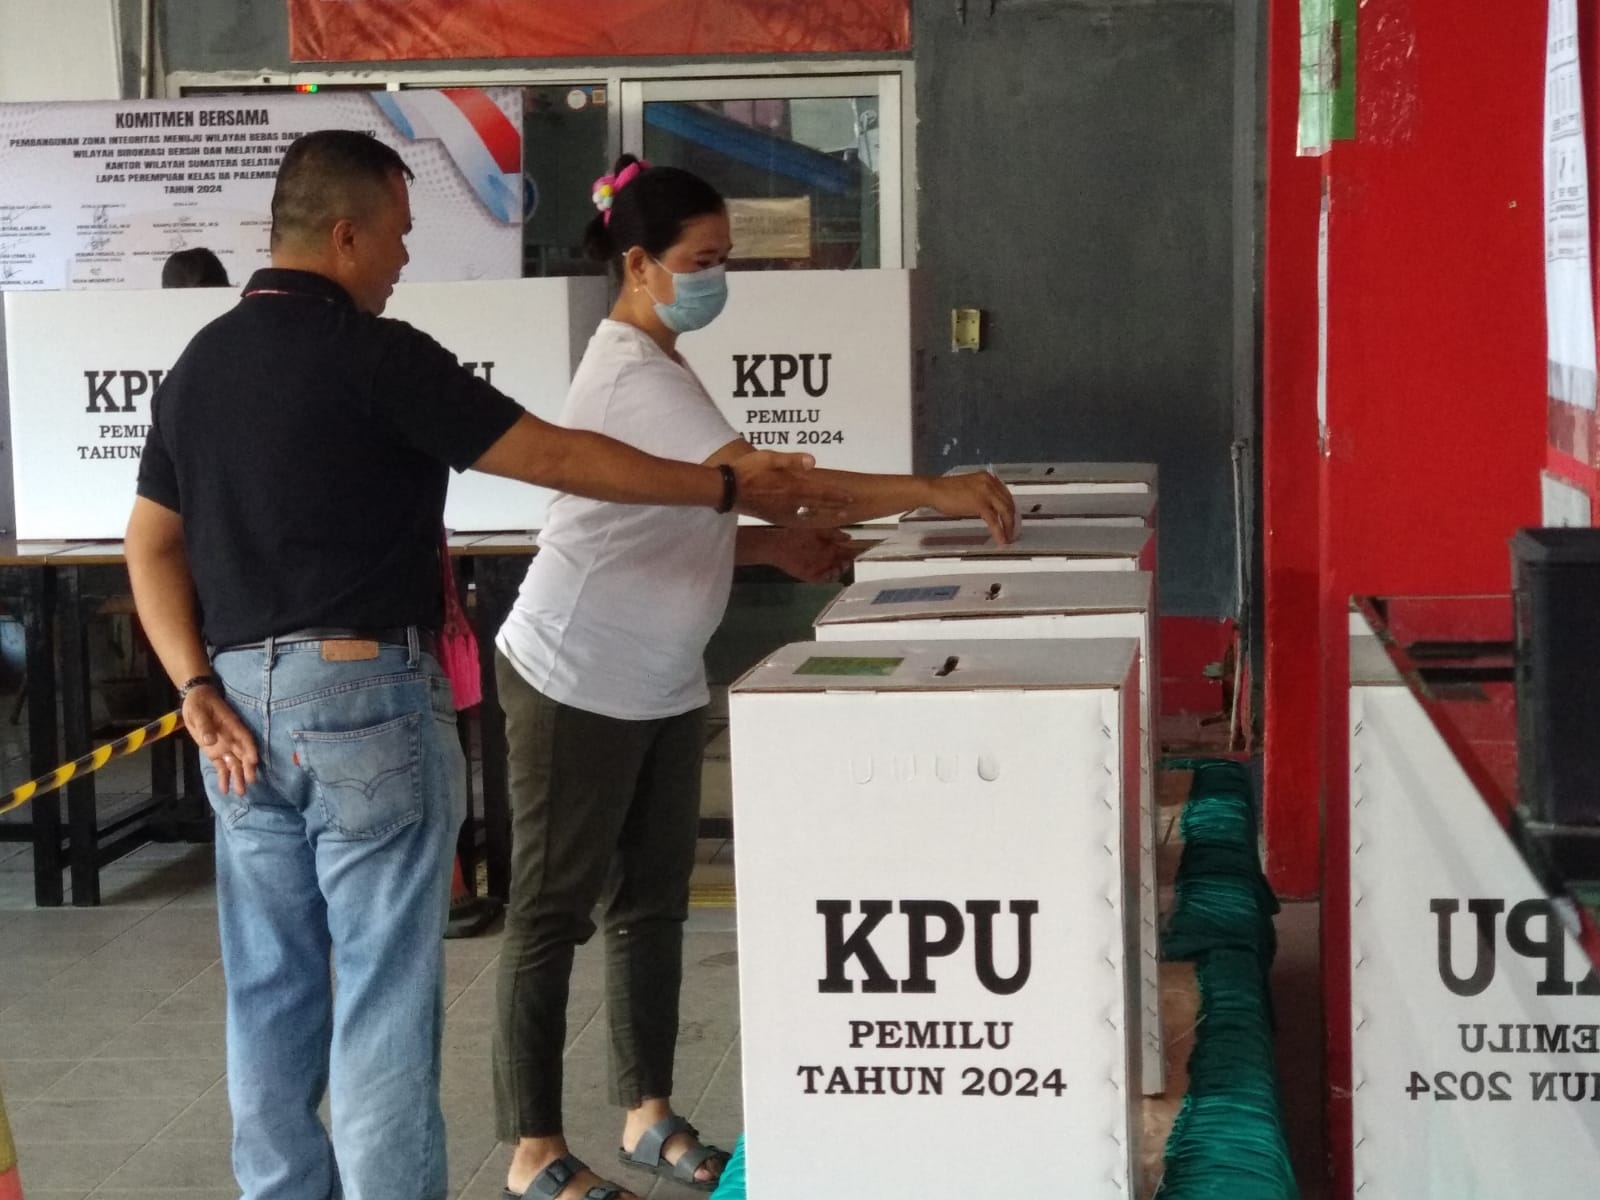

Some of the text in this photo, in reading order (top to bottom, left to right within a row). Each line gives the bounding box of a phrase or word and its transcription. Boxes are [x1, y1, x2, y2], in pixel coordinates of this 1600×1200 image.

[115, 109, 269, 128] KOMITMEN BERSAMA
[9, 137, 80, 147] PEMBANGUNAN
[82, 136, 106, 145] ZONA
[108, 135, 161, 145] INTEGRITAS
[163, 134, 202, 143] MENUJU
[205, 133, 247, 142] WILAYAH
[249, 132, 279, 141] BEBAS
[73, 149, 114, 158] WILAYAH
[117, 148, 165, 157] BIROKRASI
[168, 147, 200, 156] BERSIH
[203, 146, 222, 155] DAN
[225, 145, 272, 155] MELAYANI
[105, 158, 280, 170] KANTOR WILAYAH SUMATERA SELATAN
[96, 174, 125, 183] LAPAS
[128, 173, 184, 182] PEREMPUAN
[187, 172, 216, 181] KELAS
[164, 185, 222, 194] TAHUN 2024
[732, 353, 832, 398] KPU
[746, 409, 820, 424] PEMILU
[796, 430, 844, 444] 2024
[77, 446, 141, 459] TAHUN
[816, 899, 1039, 996] KPU
[849, 1020, 1014, 1050] PEMILU
[797, 1065, 1067, 1097] TAHUN 2024
